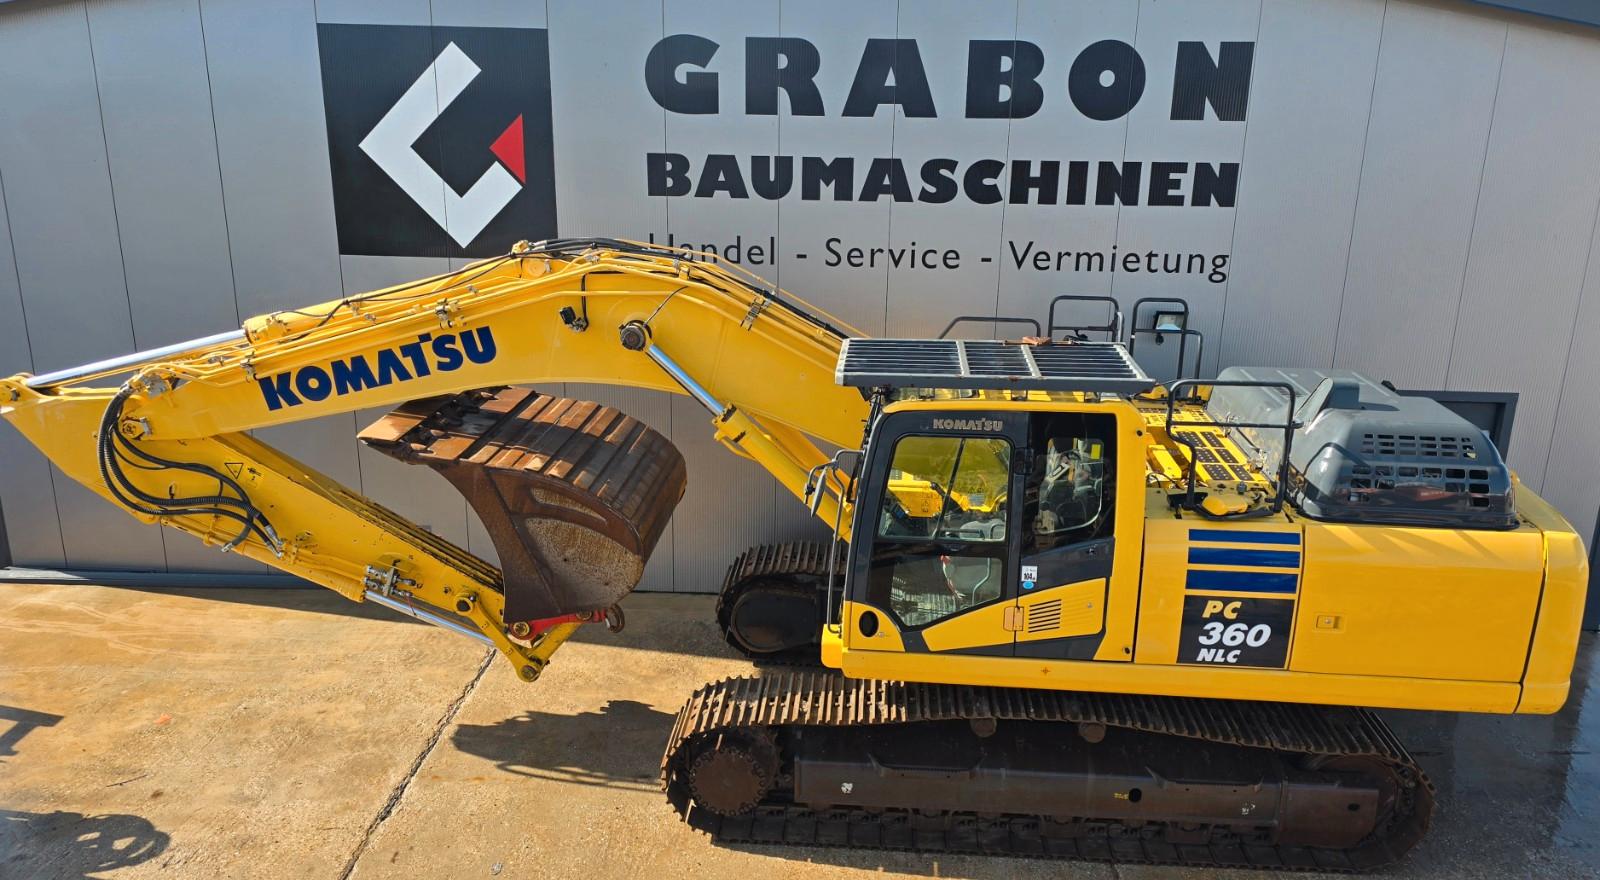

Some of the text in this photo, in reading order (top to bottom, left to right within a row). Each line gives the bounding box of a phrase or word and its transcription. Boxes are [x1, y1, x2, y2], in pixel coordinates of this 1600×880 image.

[645, 34, 1255, 121] GRABON
[646, 152, 1240, 208] BAUMASCHINEN
[824, 238, 961, 269] Service
[1008, 240, 1230, 284] Vermietung
[258, 325, 497, 411] KOMATSU
[933, 418, 1003, 431] KOMATSU
[1202, 600, 1242, 619] PC
[1198, 621, 1271, 647] 360
[1196, 648, 1241, 663] NLC
